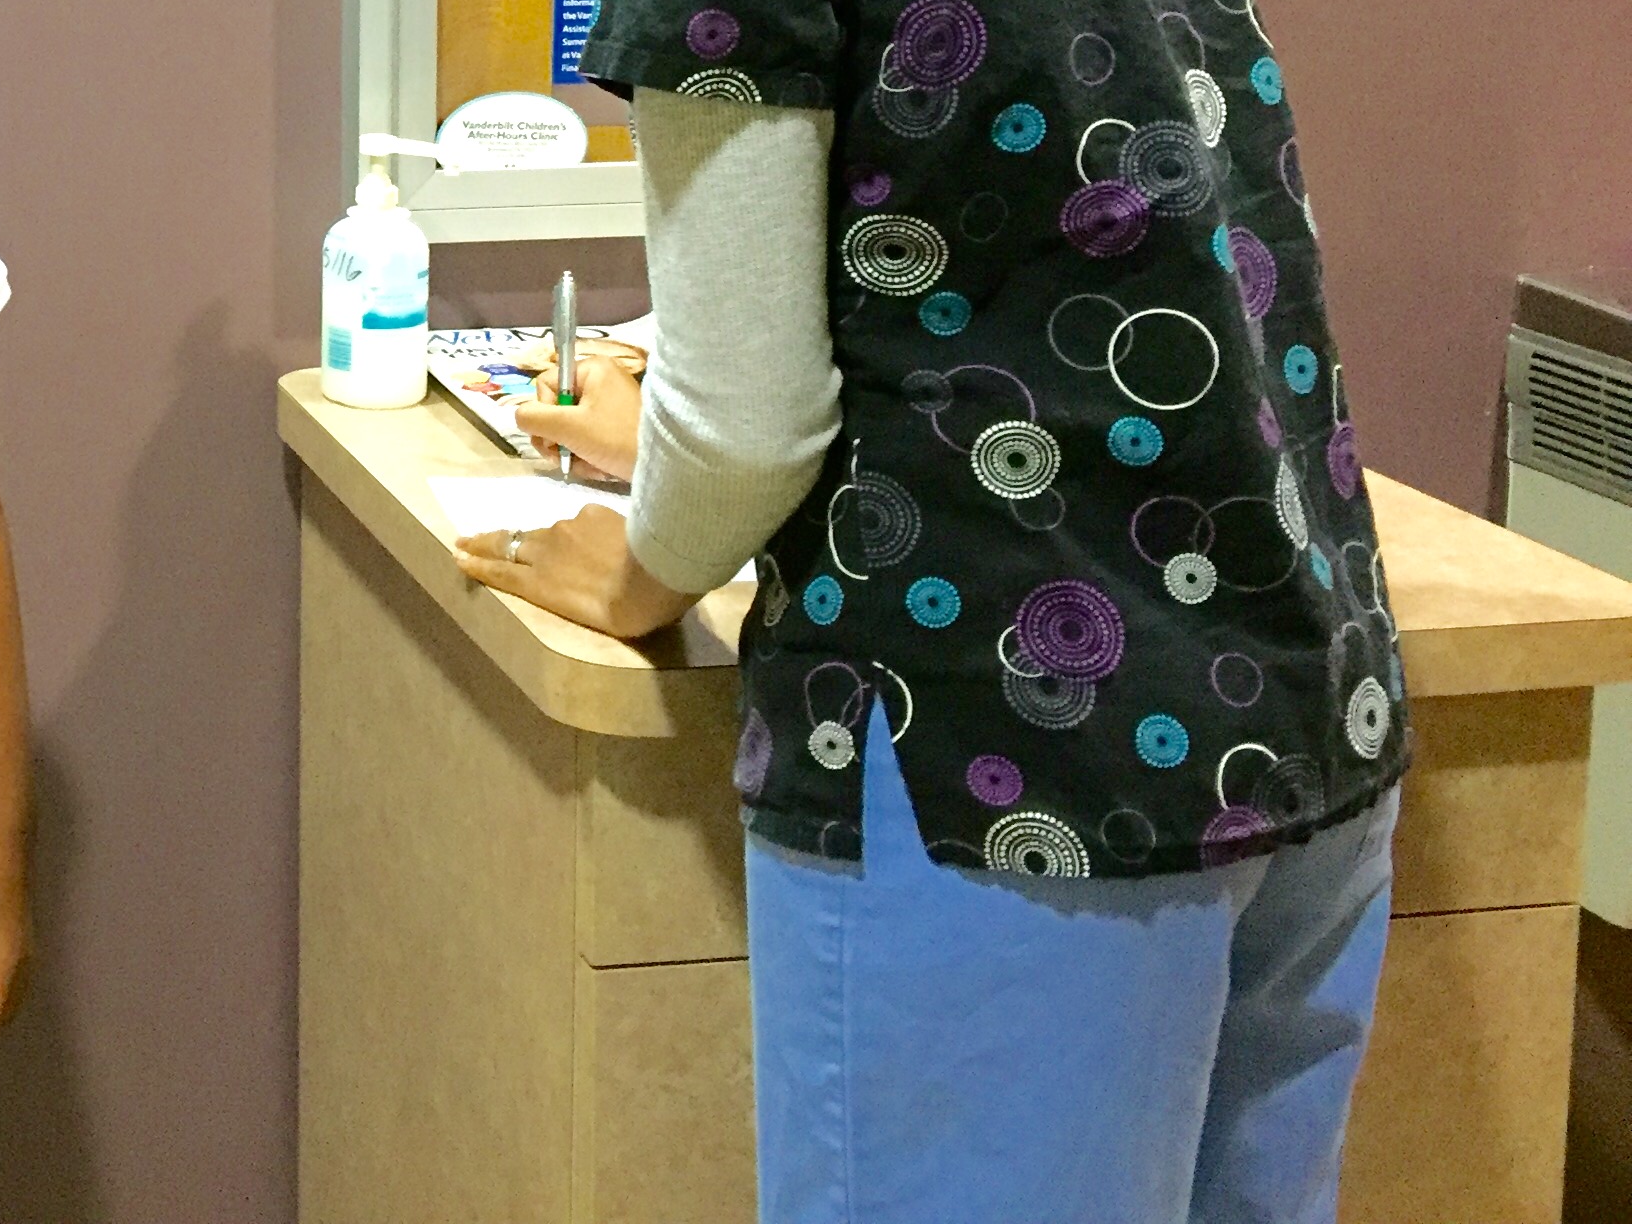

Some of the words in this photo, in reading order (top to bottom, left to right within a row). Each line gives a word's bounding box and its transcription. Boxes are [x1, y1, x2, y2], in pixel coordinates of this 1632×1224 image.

[462, 120, 514, 130] Vanderbilt
[516, 121, 567, 131] Children's
[530, 131, 559, 141] Clinic
